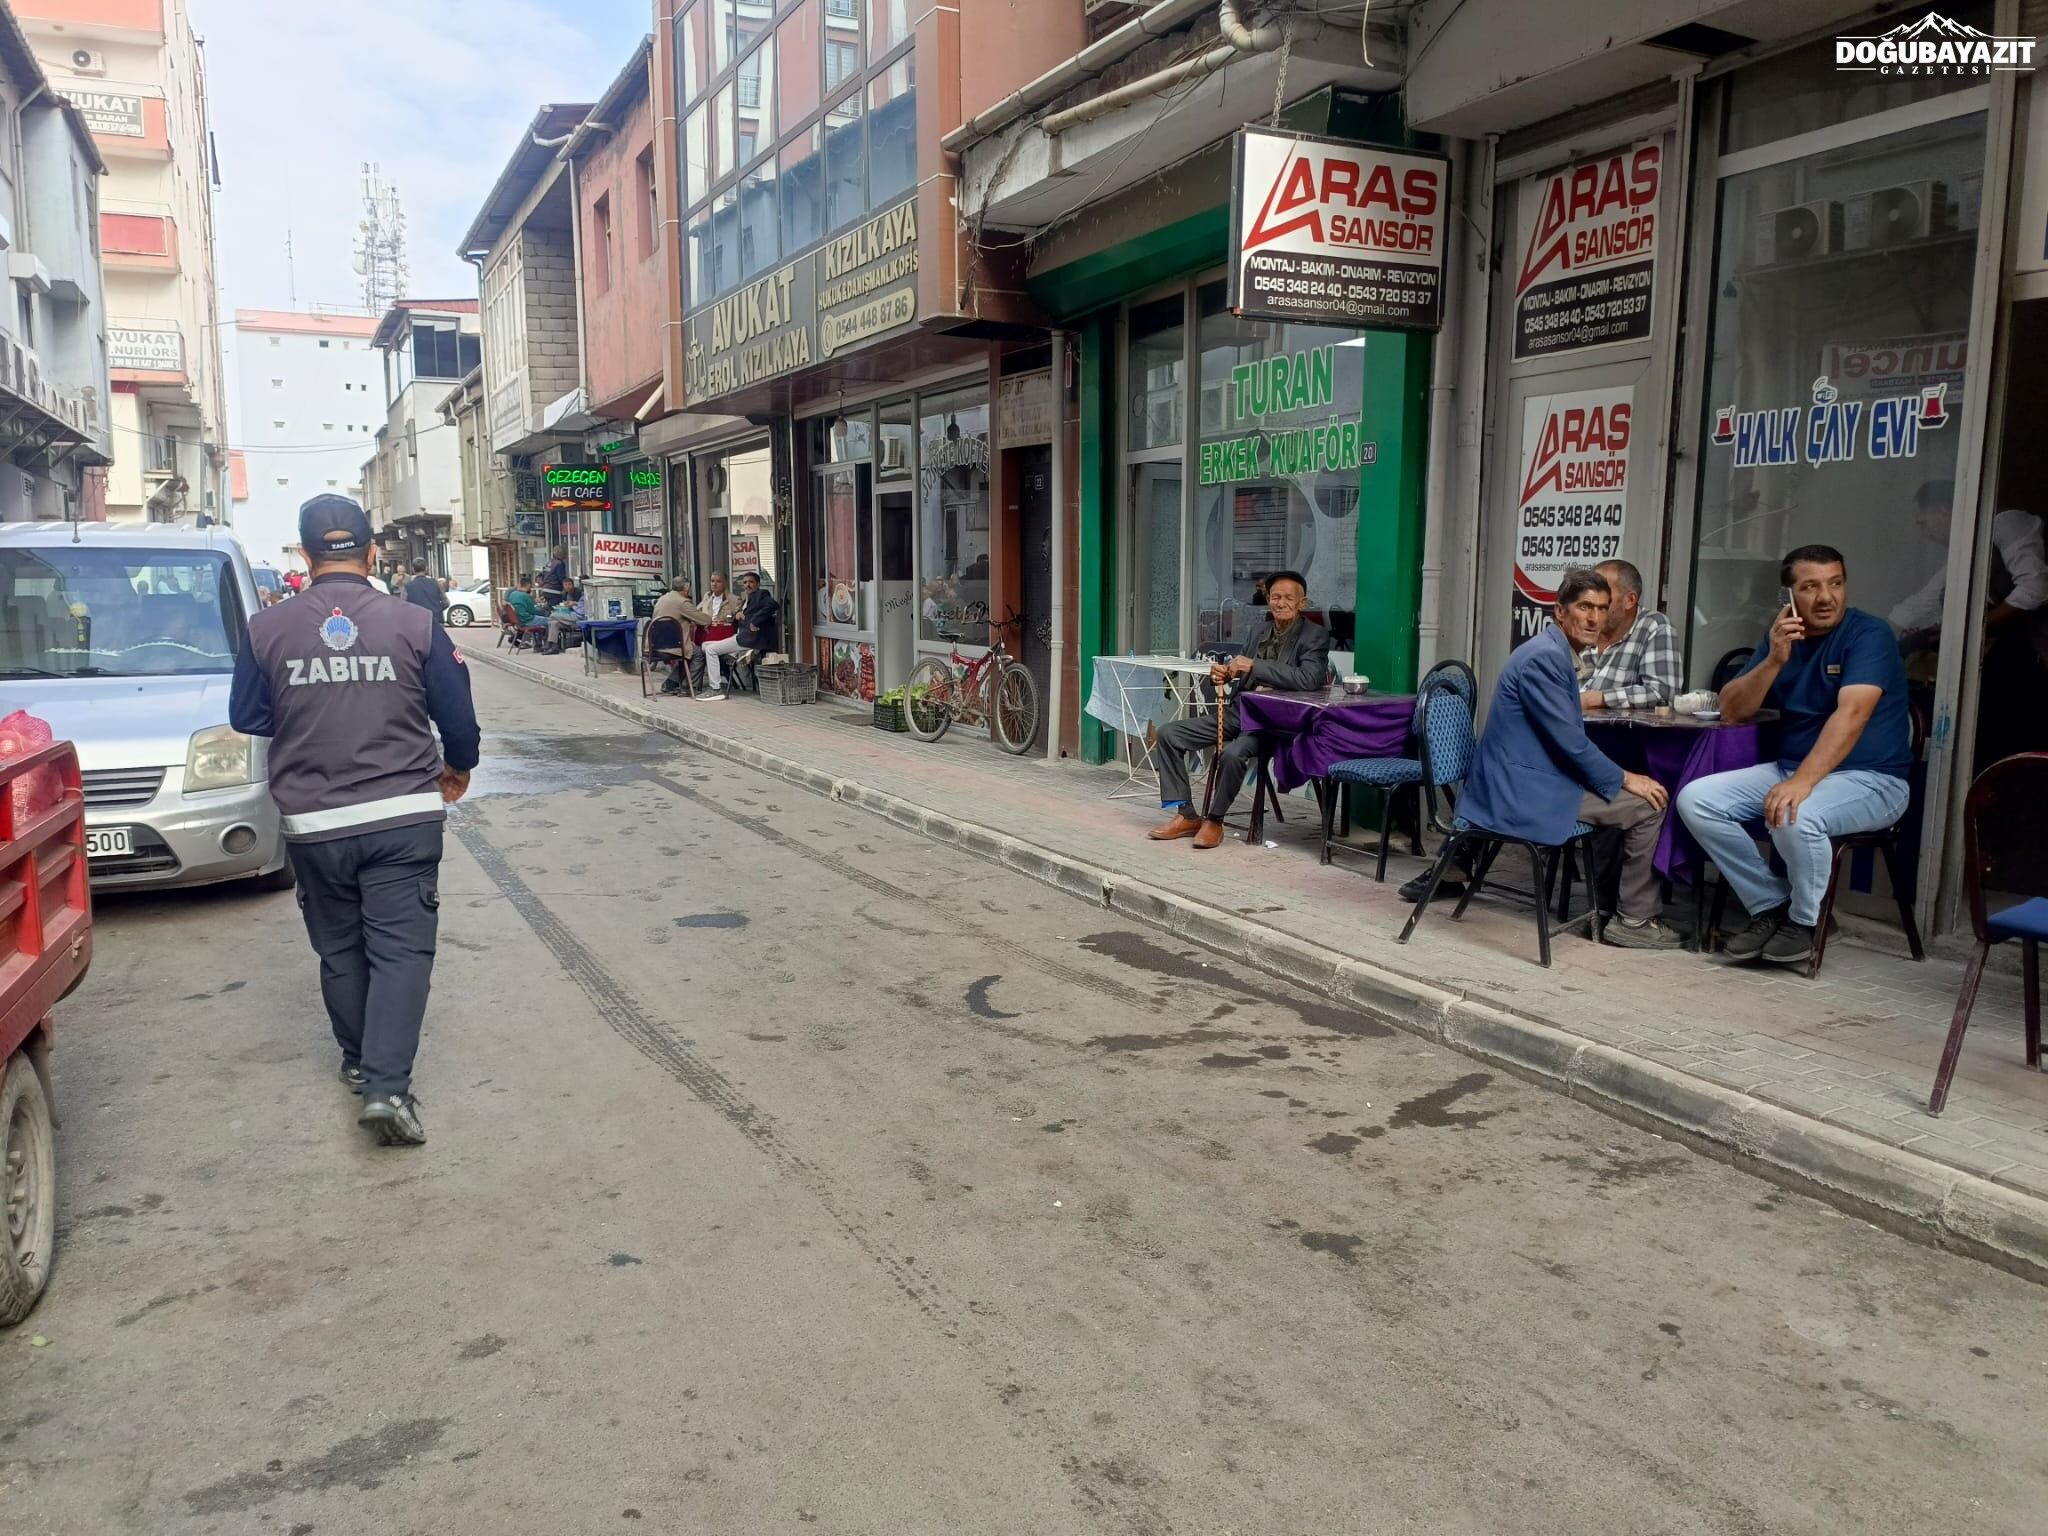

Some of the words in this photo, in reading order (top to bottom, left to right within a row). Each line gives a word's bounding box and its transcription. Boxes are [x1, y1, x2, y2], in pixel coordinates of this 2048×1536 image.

[1242, 141, 1438, 252] ARAS
[1329, 212, 1433, 251] SANSÖR
[1515, 145, 1660, 298] ARAS
[1574, 207, 1655, 264] SANSÖR
[825, 203, 918, 281] KIZILKAYA
[1250, 256, 1295, 273] MONTAJ
[1301, 260, 1335, 278] BAKIM
[1341, 264, 1382, 282] ONARIM
[1254, 276, 1285, 292] 0545
[1286, 279, 1309, 294] 348
[1310, 281, 1326, 296] 24
[1327, 283, 1341, 297] 40
[1348, 286, 1377, 301] 0543
[1379, 288, 1400, 302] 720
[1402, 290, 1416, 304] 93
[1417, 291, 1431, 305] 37
[1267, 294, 1409, 317] arasasansor04@gmail.com
[1523, 292, 1551, 311] MONTAJ
[1554, 286, 1577, 305] BAKIM
[1580, 279, 1610, 300] ONARIM
[711, 265, 796, 354] AVUKAT
[836, 315, 858, 341] 0544
[860, 305, 878, 331] 448
[880, 300, 893, 324] 87
[895, 295, 908, 319] 86
[1525, 315, 1543, 334] 0545
[1544, 312, 1559, 330] 348
[1560, 310, 1569, 327] 24
[1570, 308, 1581, 325] 40
[1585, 303, 1605, 322] 0543
[1607, 300, 1622, 318] 720
[1623, 297, 1634, 315] 93
[1635, 294, 1647, 312] 37
[1528, 321, 1629, 350] arasasansor04@gmail.com
[708, 357, 738, 397] EROL
[740, 326, 811, 386] KIZILKAYA
[1232, 345, 1335, 420] TURAN
[1735, 408, 1801, 467] HALK
[1806, 402, 1863, 469] ÇAY
[1869, 396, 1920, 459] EVİ
[1200, 436, 1261, 485] ERKEK
[1363, 446, 1373, 461] 20
[1520, 402, 1631, 507] ARAS
[1564, 452, 1626, 490] SANSÖR
[546, 470, 608, 486] GEZEGEN
[551, 486, 572, 498] NET
[574, 486, 603, 498] CAFE
[1523, 506, 1555, 528] 0545
[1557, 505, 1582, 527] 348
[1584, 505, 1601, 526] 24
[1604, 504, 1622, 526] 40
[331, 541, 355, 550] ZABITA
[595, 556, 630, 568] DİLEKÇE
[632, 558, 663, 569] YAZILIR
[1522, 536, 1553, 557] 0543
[1556, 536, 1580, 557] 720
[1582, 536, 1600, 557] 93
[1602, 536, 1620, 557] 37
[286, 655, 397, 687] ZABITA
[87, 831, 126, 853] 500
